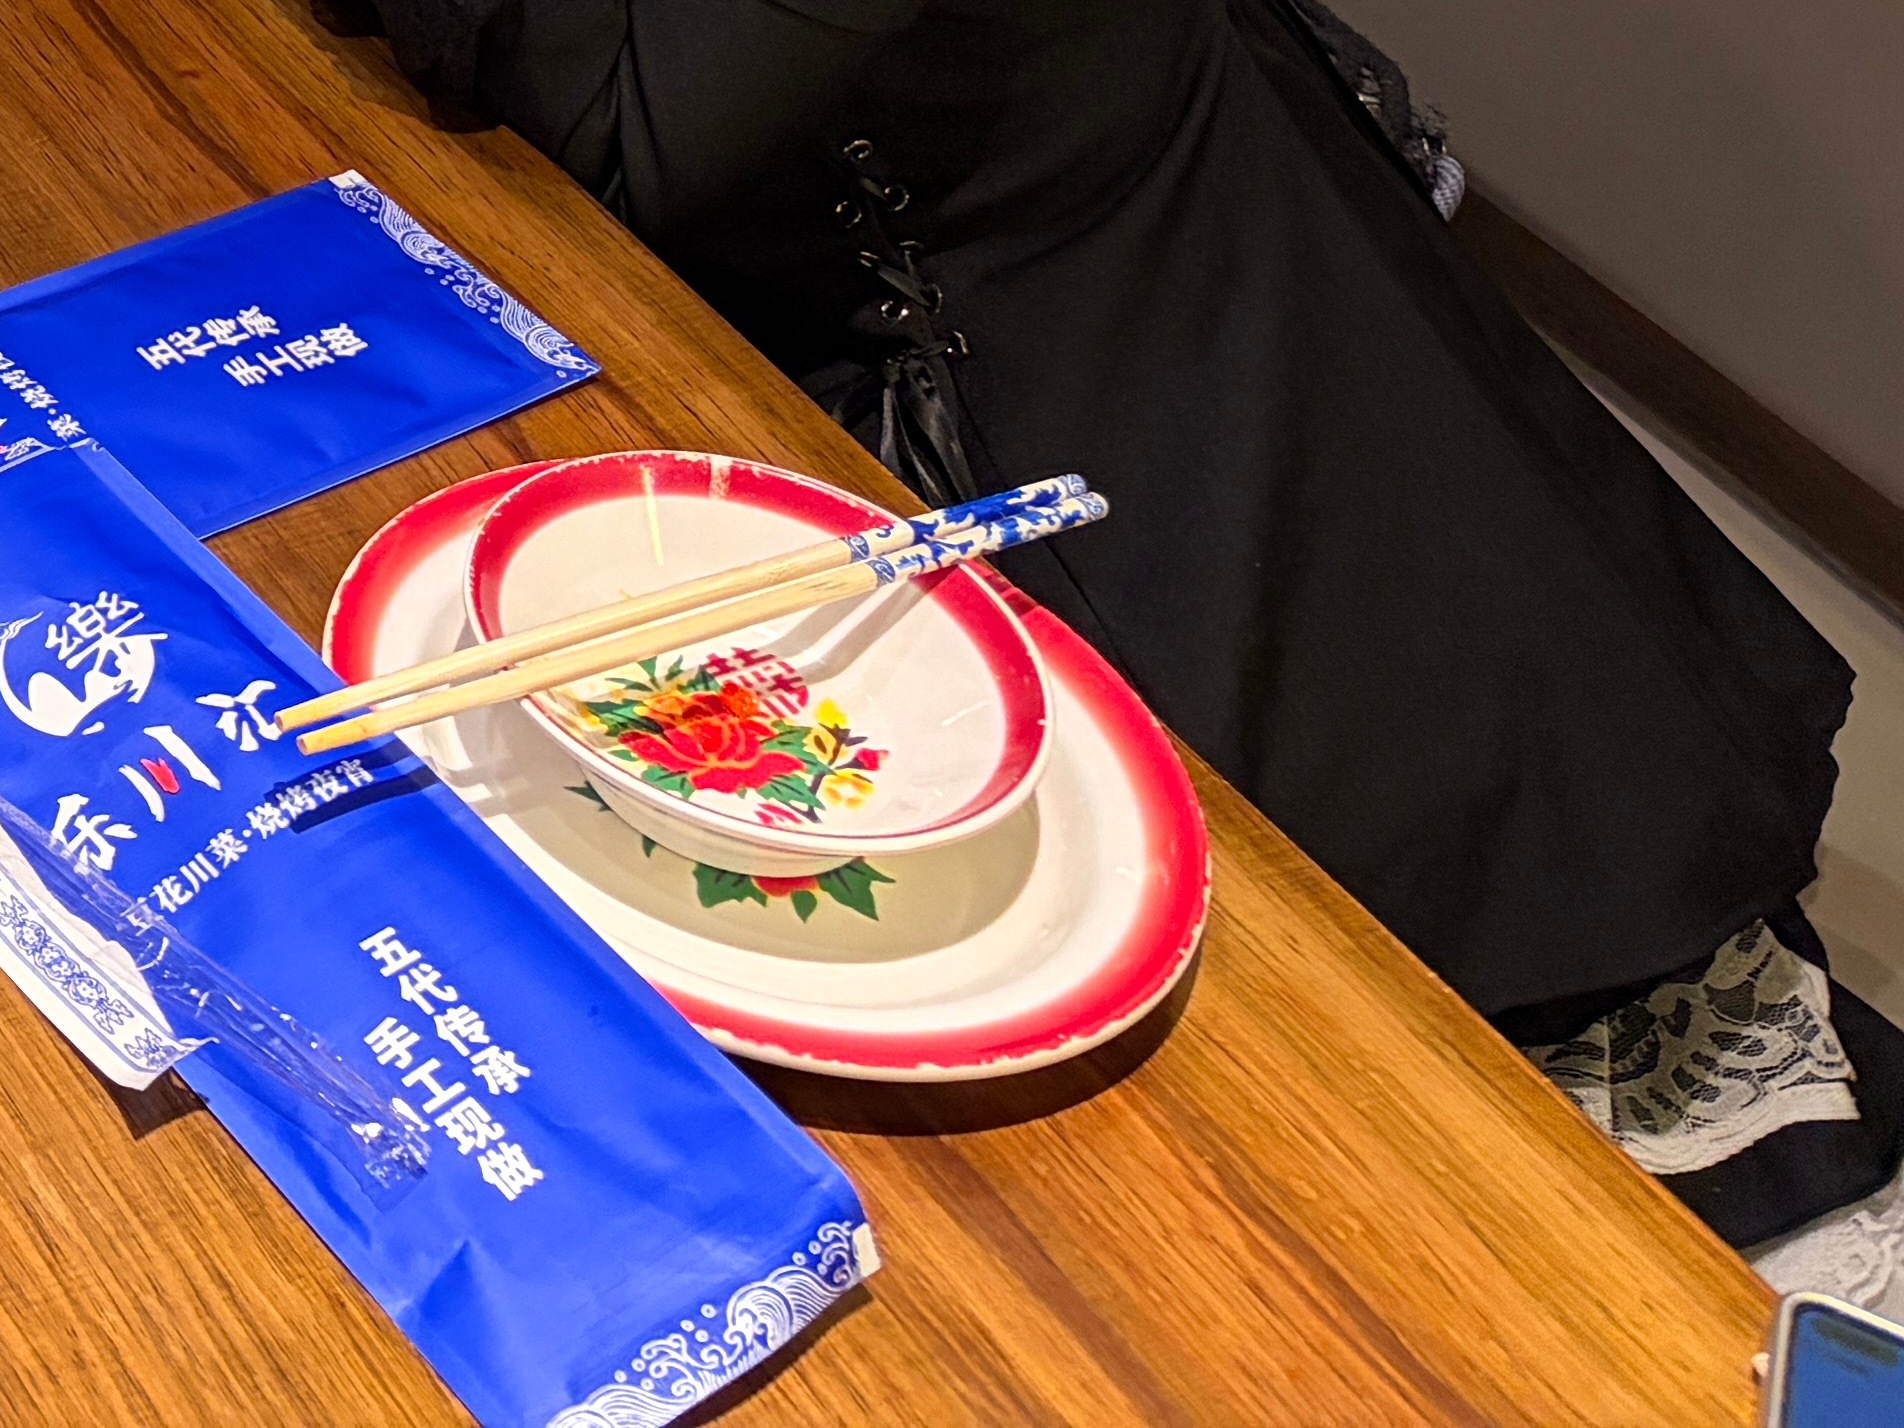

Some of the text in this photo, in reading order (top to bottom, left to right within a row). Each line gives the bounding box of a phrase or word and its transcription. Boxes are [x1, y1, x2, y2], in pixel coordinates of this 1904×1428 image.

[135, 304, 280, 373] 五代传承
[222, 321, 372, 390] 手工现做
[50, 679, 284, 872] 乐川汇
[358, 925, 533, 1095] 五代传承
[362, 1015, 546, 1203] 手工现做
